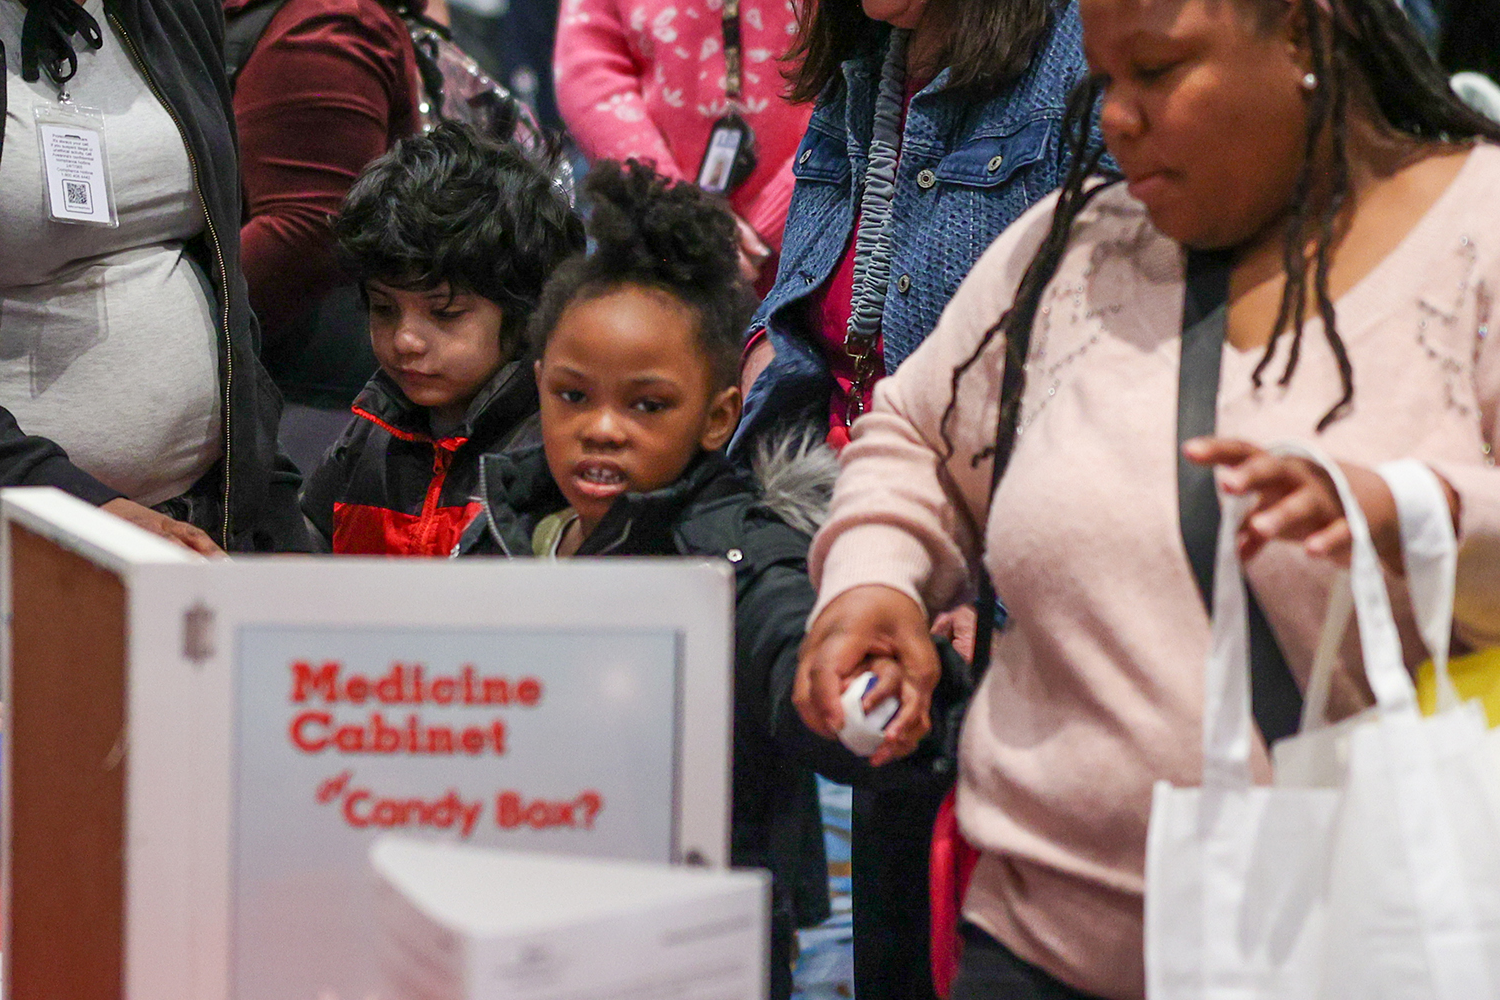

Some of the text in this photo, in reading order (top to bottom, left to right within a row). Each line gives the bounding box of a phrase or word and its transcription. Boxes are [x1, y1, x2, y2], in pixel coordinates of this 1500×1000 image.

[290, 661, 542, 706] Medicine
[289, 711, 506, 755] Cabinet
[342, 787, 481, 836] Candy
[495, 790, 603, 830] Box?
